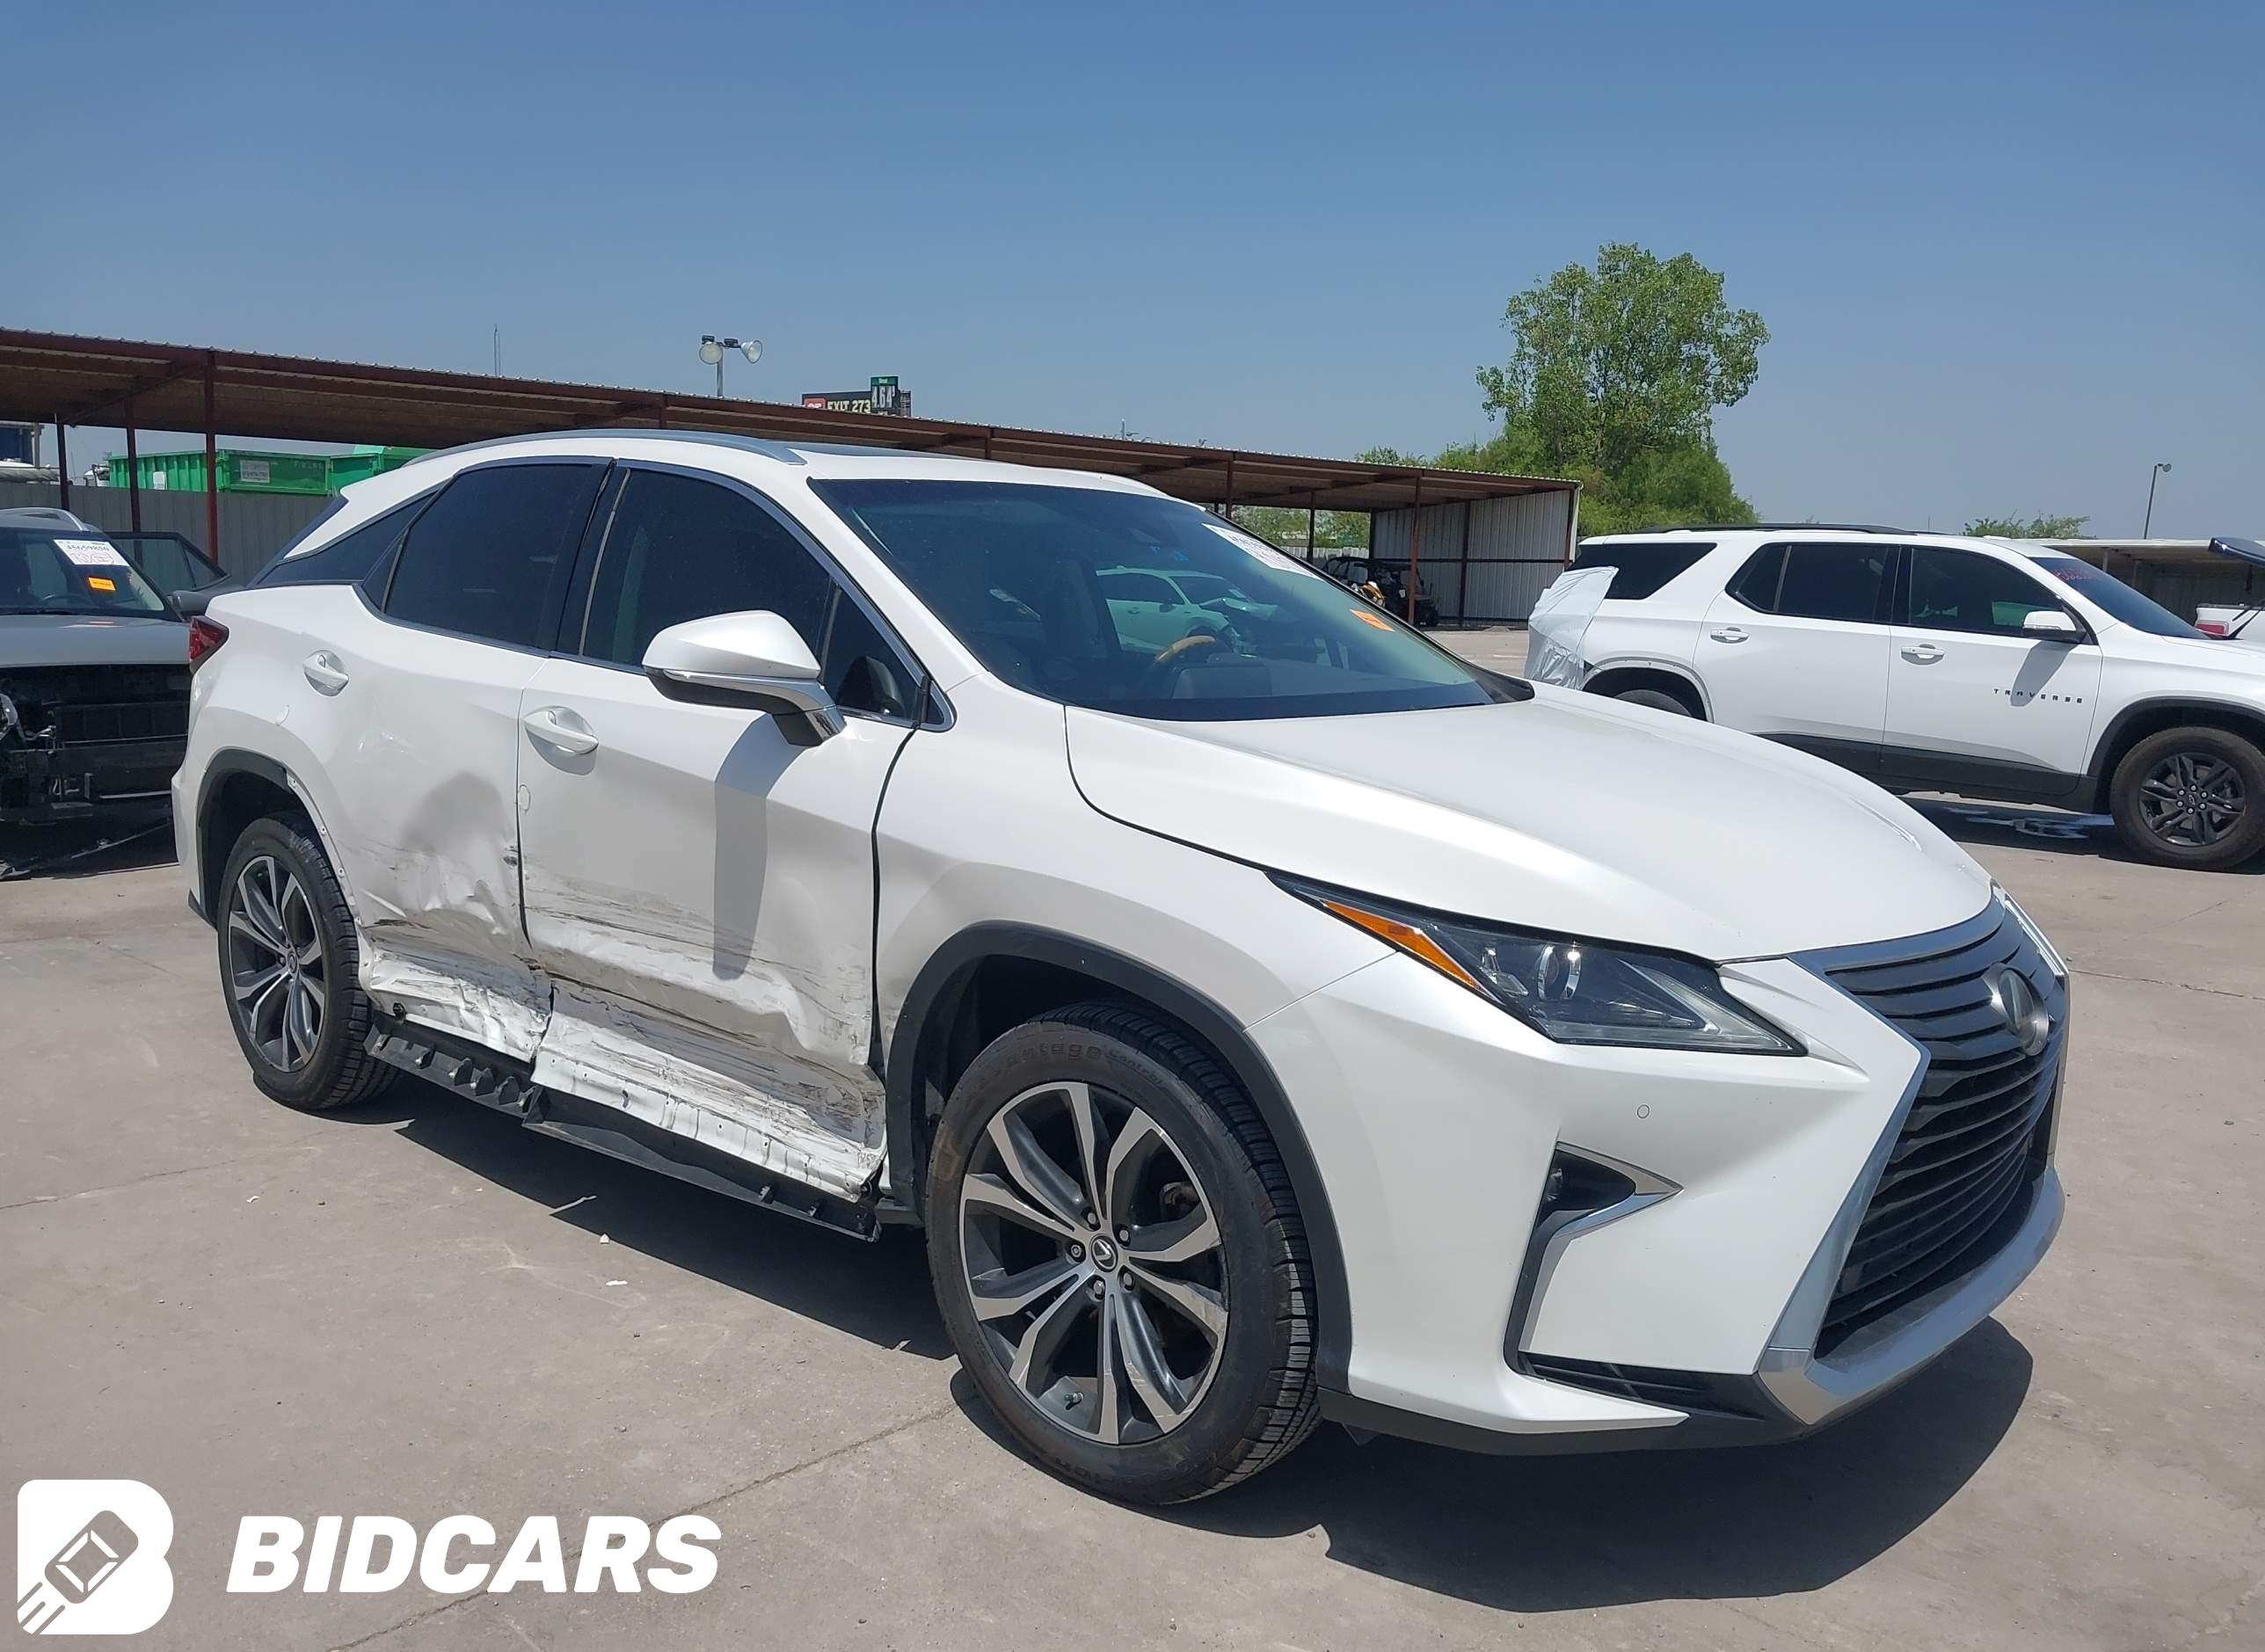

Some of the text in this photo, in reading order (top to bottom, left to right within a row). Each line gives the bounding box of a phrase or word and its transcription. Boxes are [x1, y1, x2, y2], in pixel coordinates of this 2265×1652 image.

[827, 400, 849, 411] EXIT
[852, 399, 870, 414] 273
[1993, 688, 2082, 703] TRAVERSE
